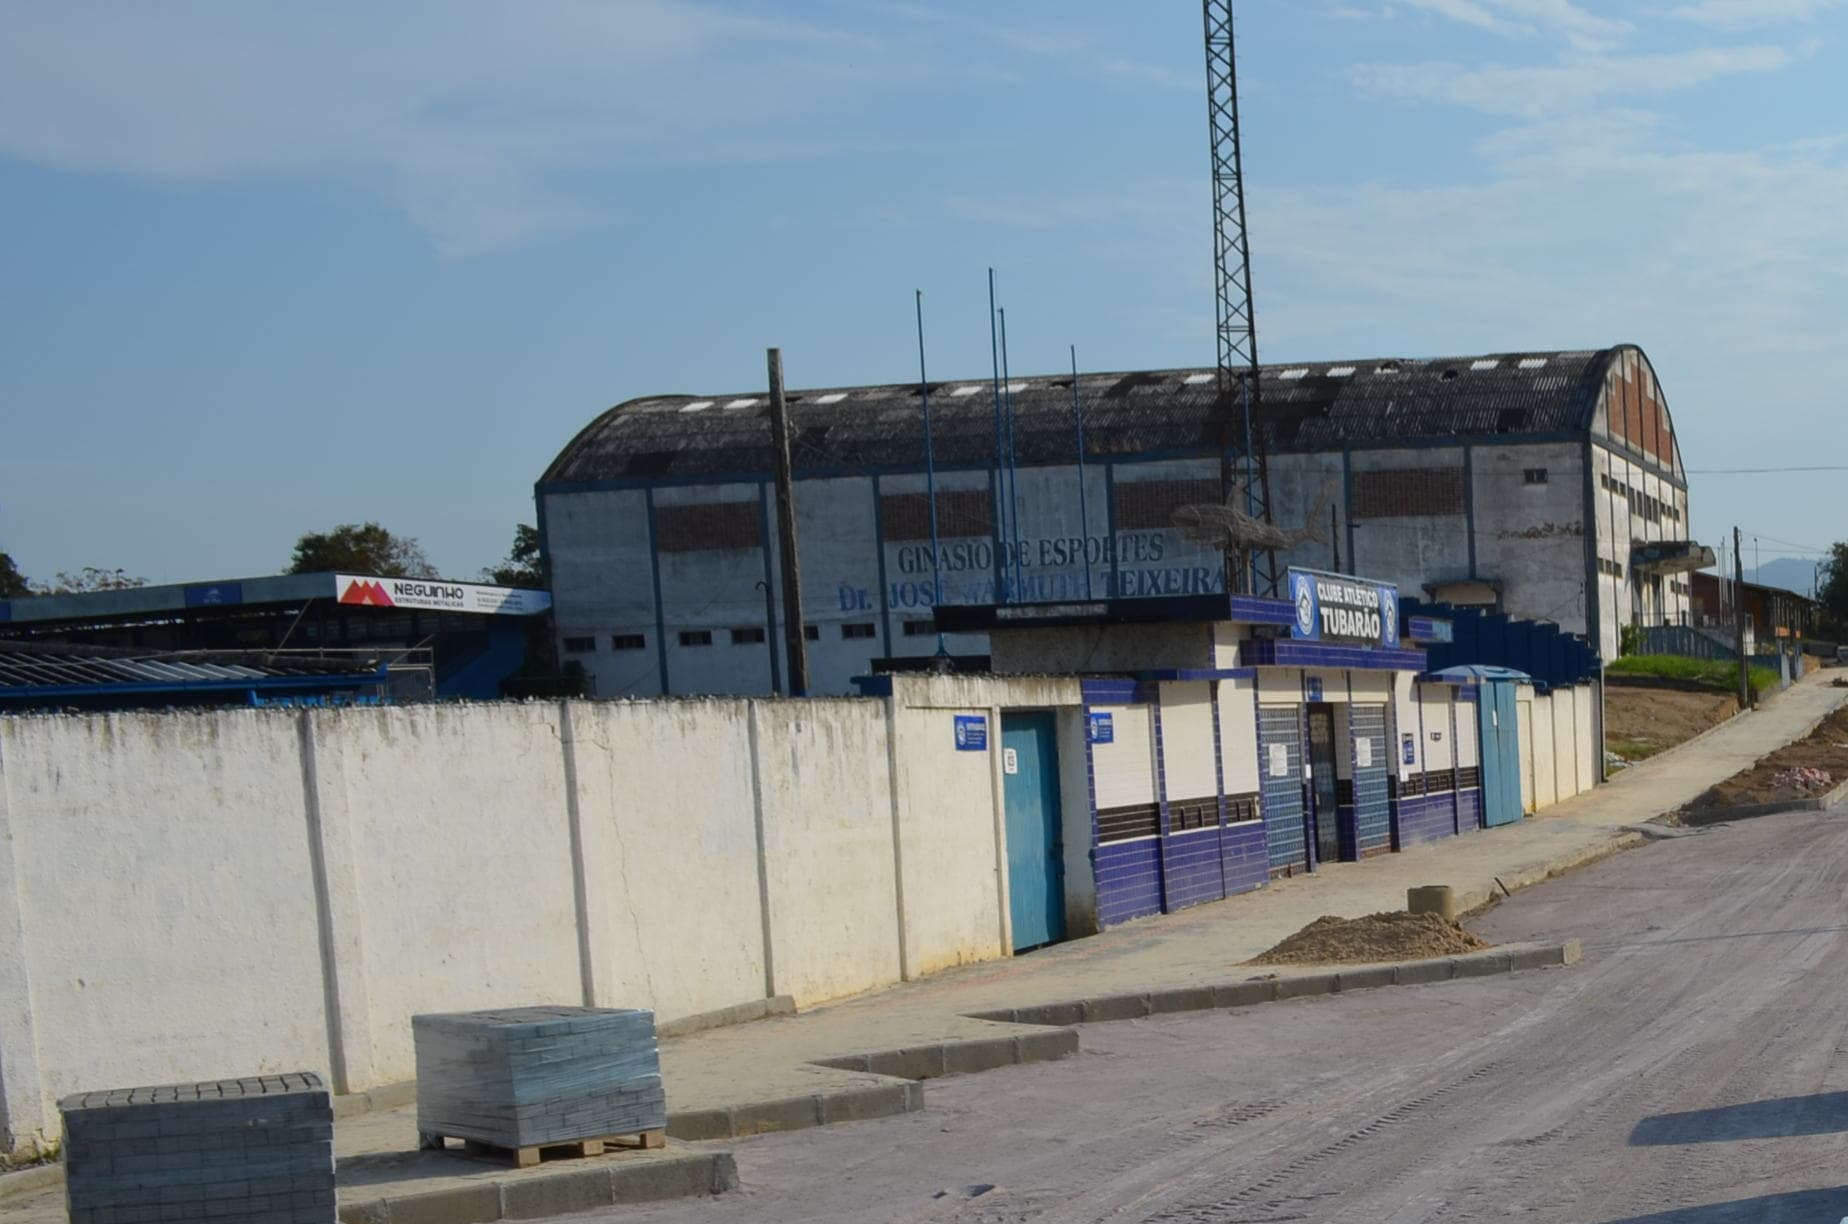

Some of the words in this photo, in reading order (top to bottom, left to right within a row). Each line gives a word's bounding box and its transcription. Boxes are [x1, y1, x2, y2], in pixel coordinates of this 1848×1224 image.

[1039, 533, 1164, 567] ESPORTES
[394, 582, 464, 599] NEGUINHO
[1100, 566, 1226, 598] TEIXEIRA
[1317, 583, 1343, 602] CLUBE
[1343, 585, 1379, 608] ATLÉTICO
[1320, 607, 1380, 639] TUBARÃO
